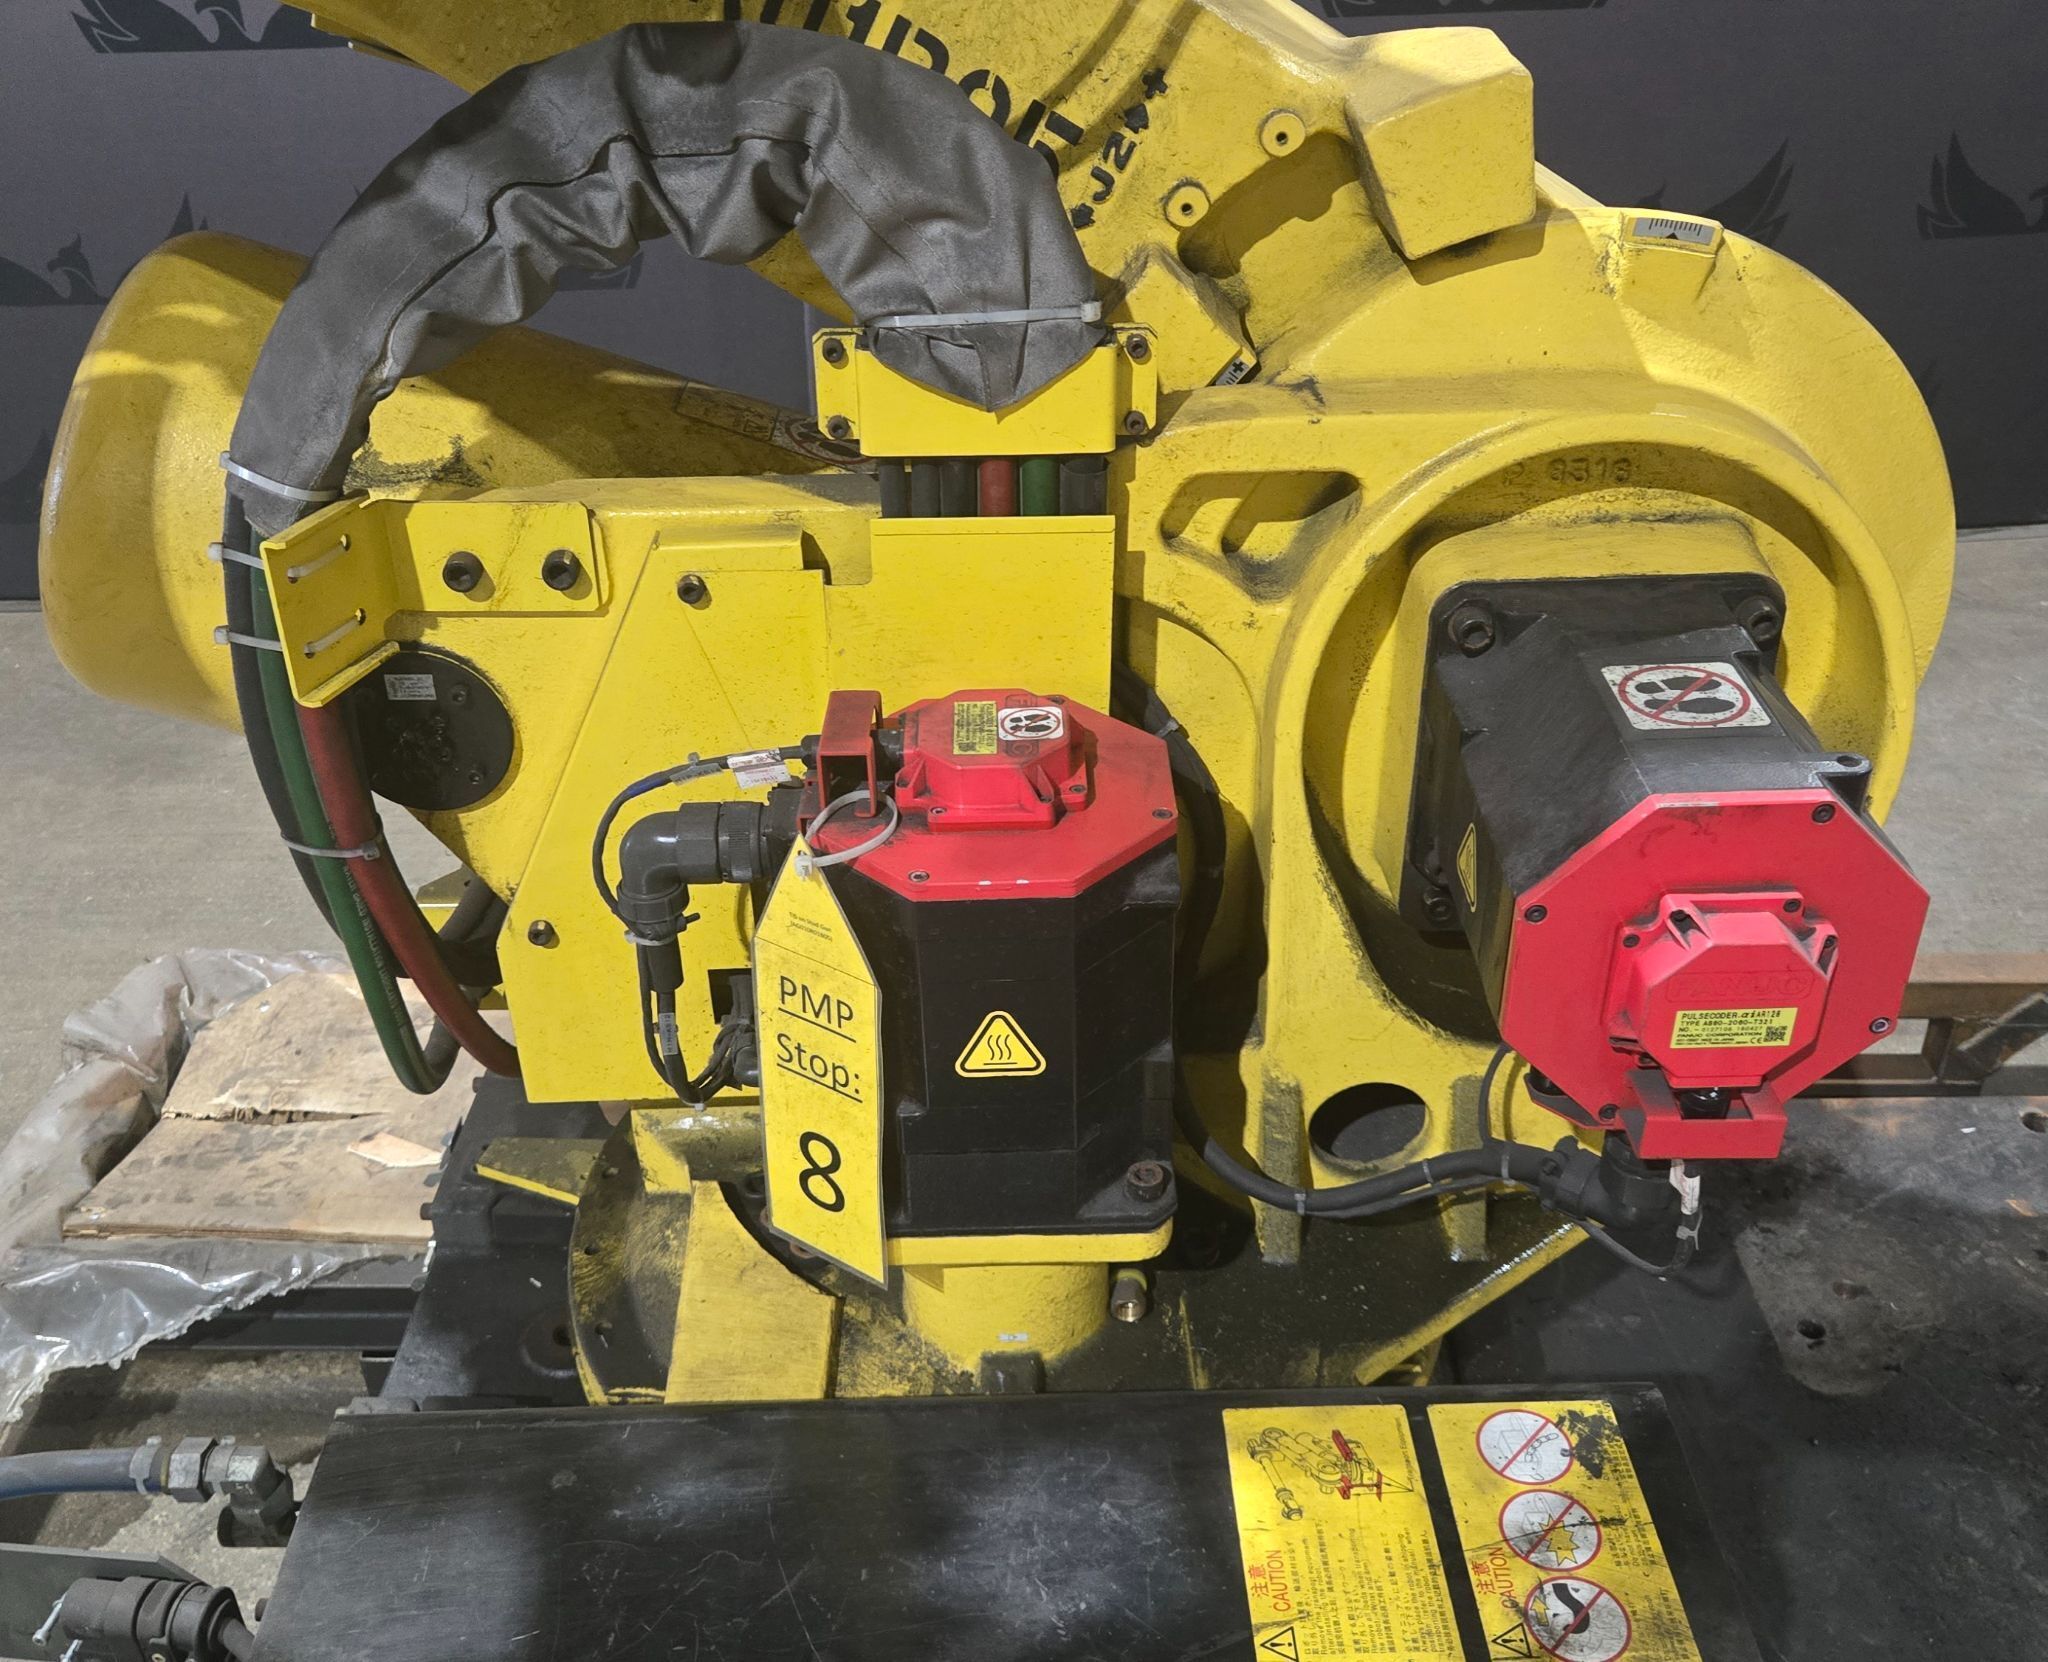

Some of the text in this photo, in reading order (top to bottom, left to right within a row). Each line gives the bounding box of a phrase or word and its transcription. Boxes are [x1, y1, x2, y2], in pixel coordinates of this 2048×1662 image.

[780, 975, 854, 1030] PMP
[777, 1032, 860, 1095] Stop:
[798, 1131, 845, 1213] 8
[1248, 1563, 1270, 1597] 注意
[1265, 1549, 1291, 1612] CAUTION
[1414, 1578, 1422, 1588] the
[1471, 1560, 1496, 1595] 注意
[1486, 1546, 1519, 1609] CAUTION
[1410, 1593, 1418, 1603] the
[1426, 1596, 1435, 1607] the
[1318, 1626, 1327, 1655] Remove
[1368, 1624, 1378, 1653] Remove
[1378, 1642, 1386, 1654] the
[1419, 1627, 1429, 1652] Always
